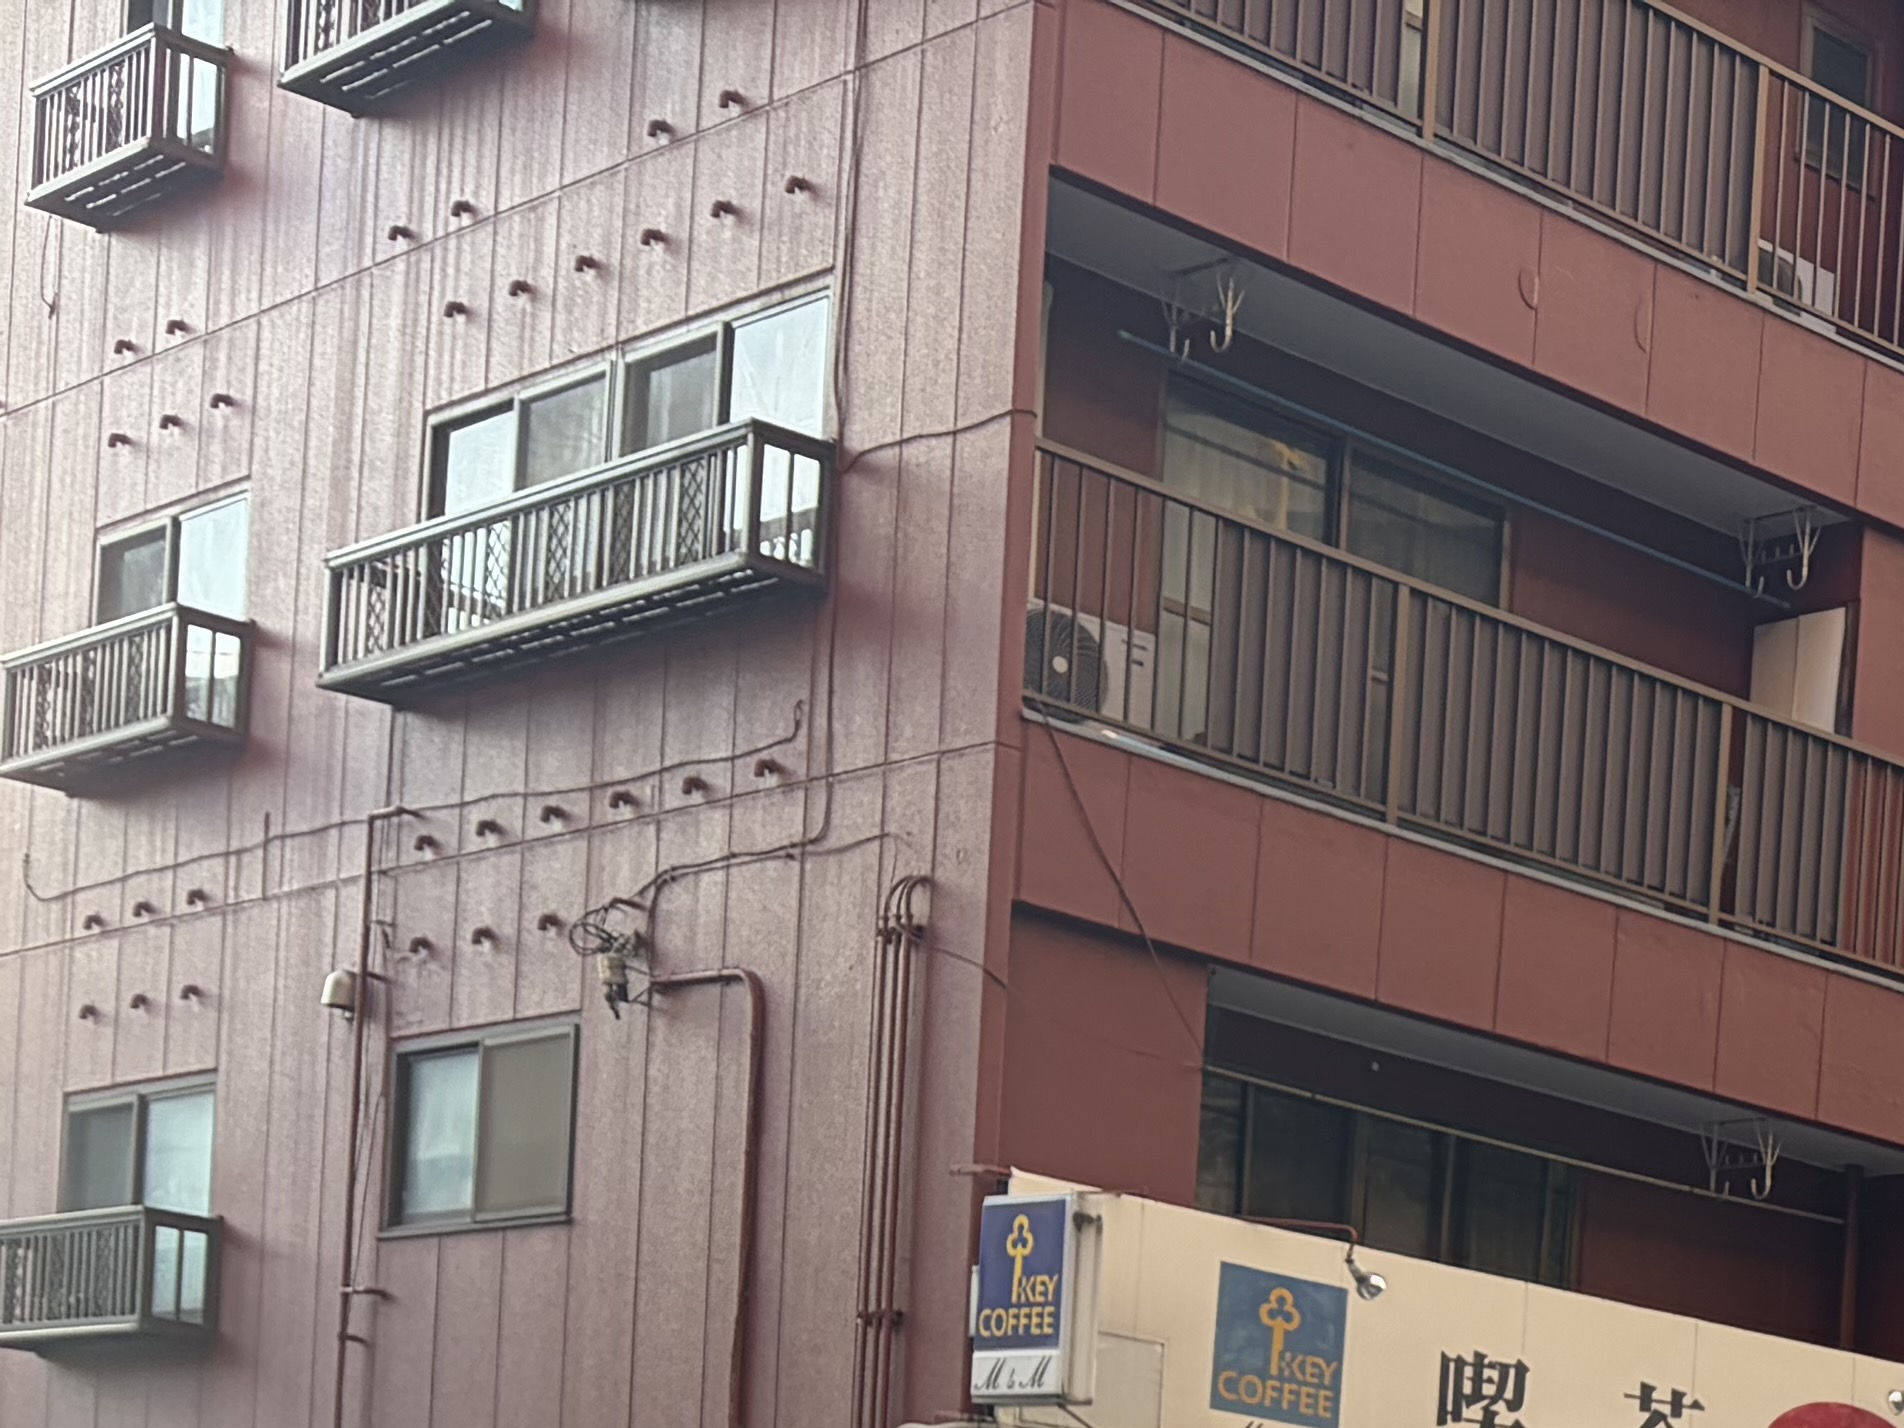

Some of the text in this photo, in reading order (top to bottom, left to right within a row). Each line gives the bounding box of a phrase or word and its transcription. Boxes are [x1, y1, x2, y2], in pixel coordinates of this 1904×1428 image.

[1016, 1273, 1058, 1304] KEY
[977, 1305, 1056, 1338] COFFEE
[973, 1357, 1004, 1391] M
[1018, 1355, 1052, 1389] M
[1279, 1352, 1340, 1386] KEY
[1216, 1369, 1334, 1420] COFFEE
